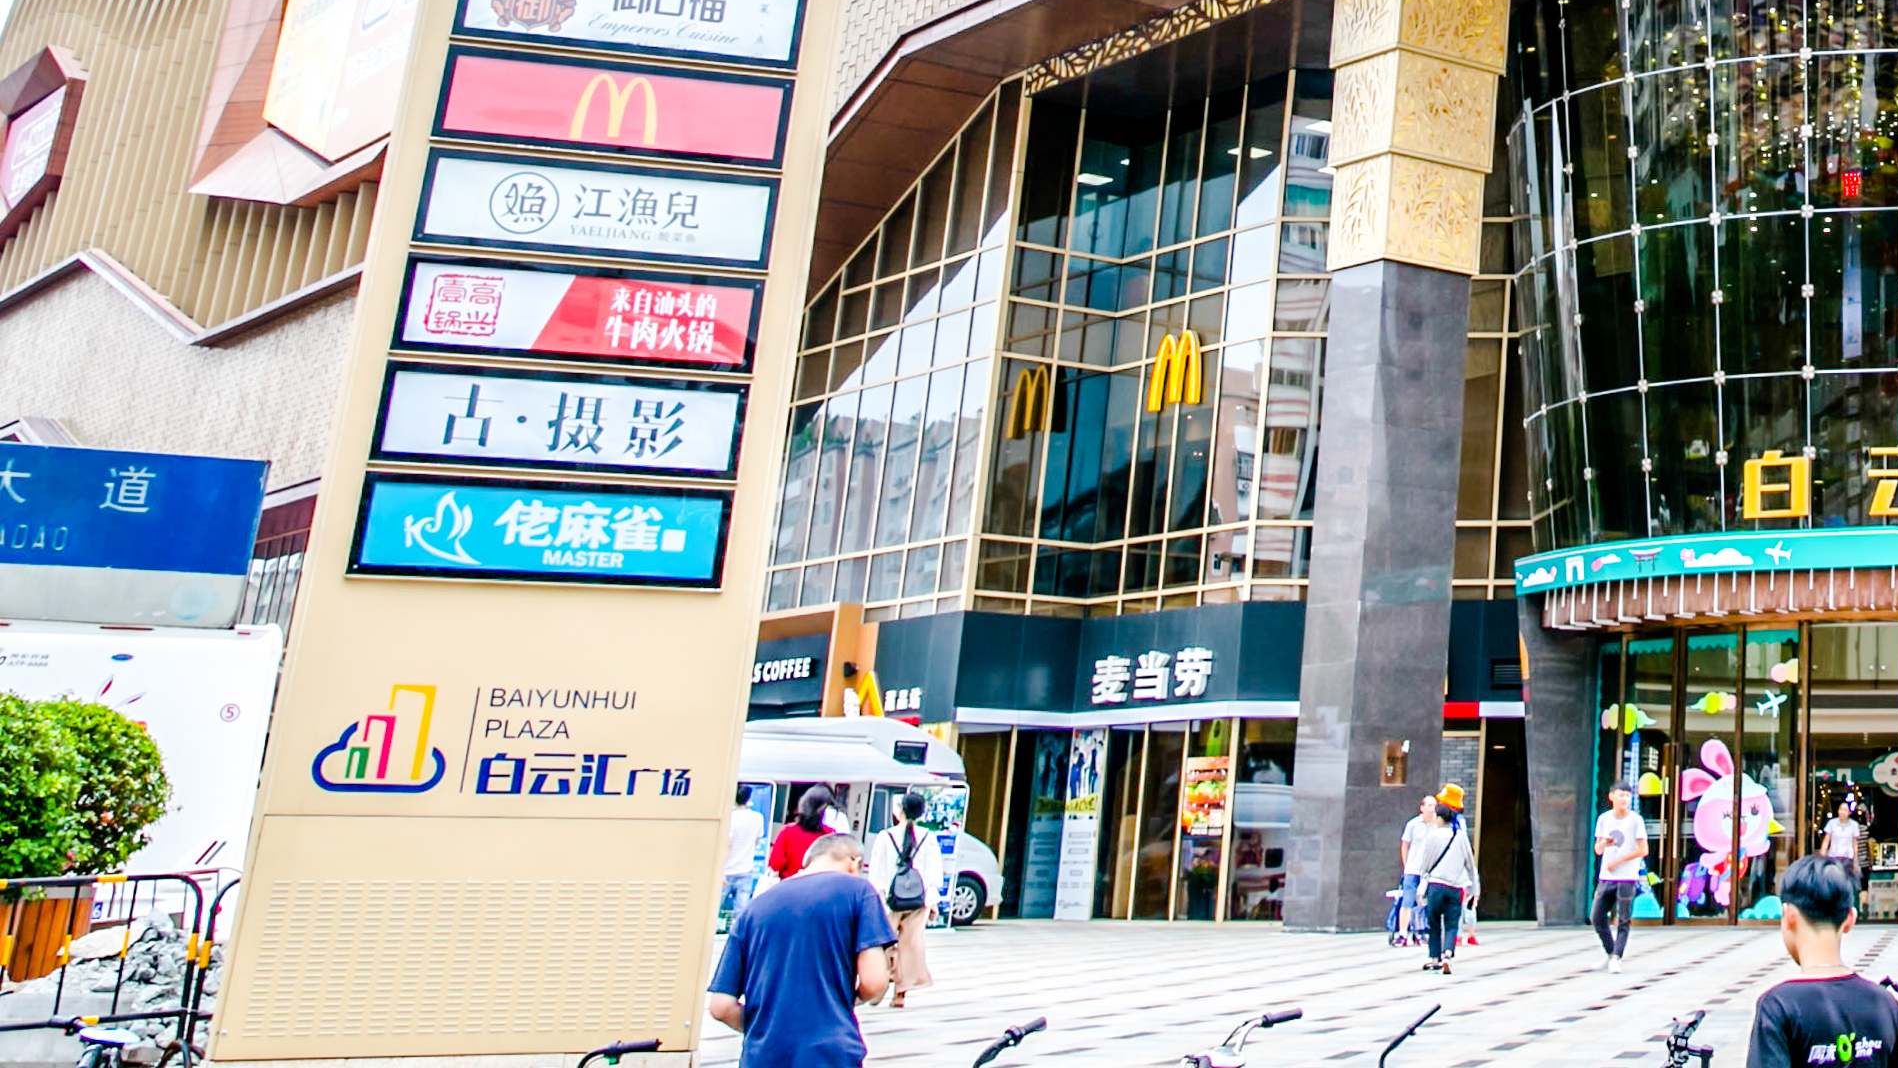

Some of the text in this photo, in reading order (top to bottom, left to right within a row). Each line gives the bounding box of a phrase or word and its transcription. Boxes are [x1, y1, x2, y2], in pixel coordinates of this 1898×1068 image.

[610, 287, 717, 319] 来自汕头的
[605, 315, 715, 354] 牛肉火锅
[494, 499, 663, 552] 佬麻雀
[543, 549, 623, 569] MASTER
[763, 657, 811, 682] COFFEE
[1092, 647, 1213, 704] 麦当劳
[490, 687, 636, 710] BAIYUNHUI
[485, 719, 570, 739] PLAZA
[475, 753, 691, 796] 白云汇广场
